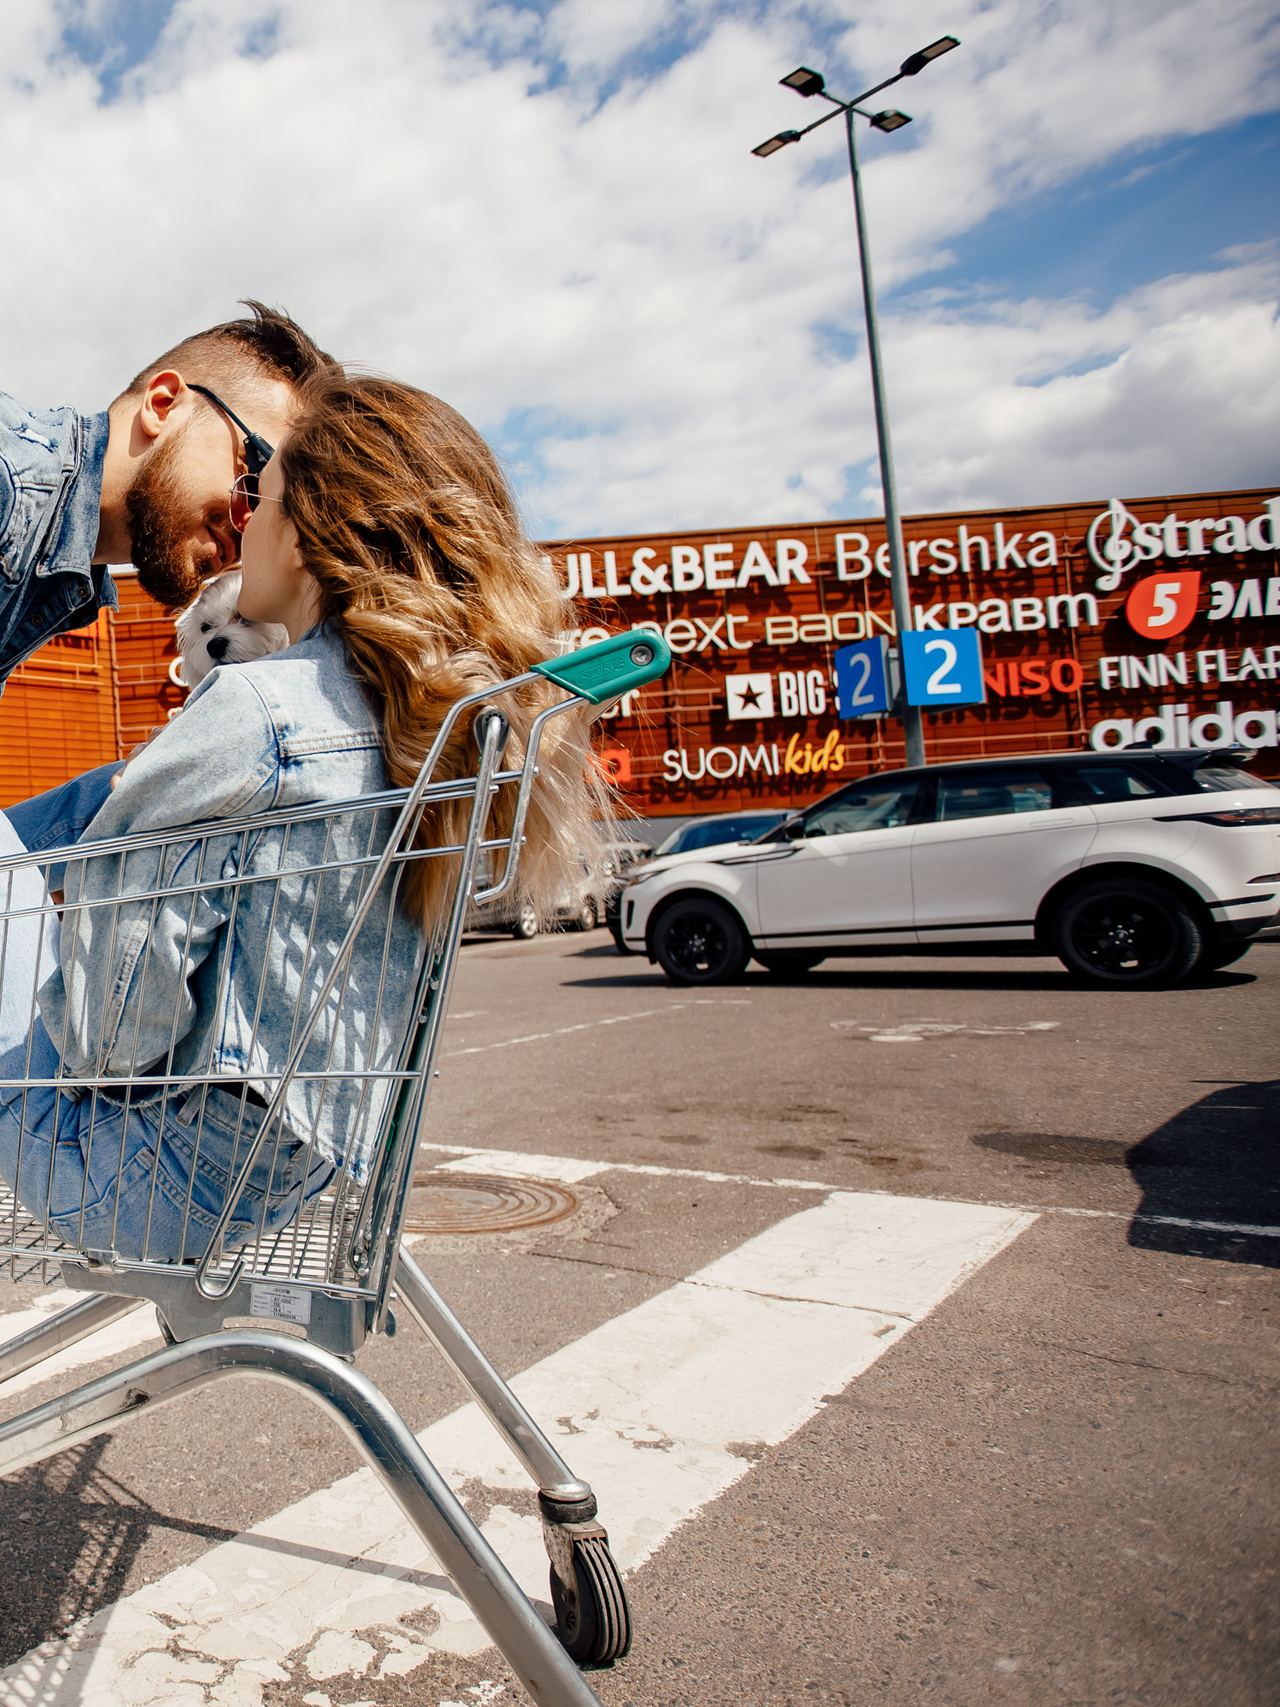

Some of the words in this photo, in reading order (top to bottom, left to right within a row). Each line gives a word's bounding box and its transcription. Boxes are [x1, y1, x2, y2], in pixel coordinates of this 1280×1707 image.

[834, 522, 1058, 581] Bershka
[1147, 582, 1182, 627] 5
[850, 652, 875, 707] 2
[924, 639, 962, 694] 2
[1099, 651, 1188, 690] FINN
[778, 670, 827, 717] BIG
[1090, 701, 1280, 751] adida
[663, 743, 780, 782] SUOMI
[784, 729, 845, 775] kids
